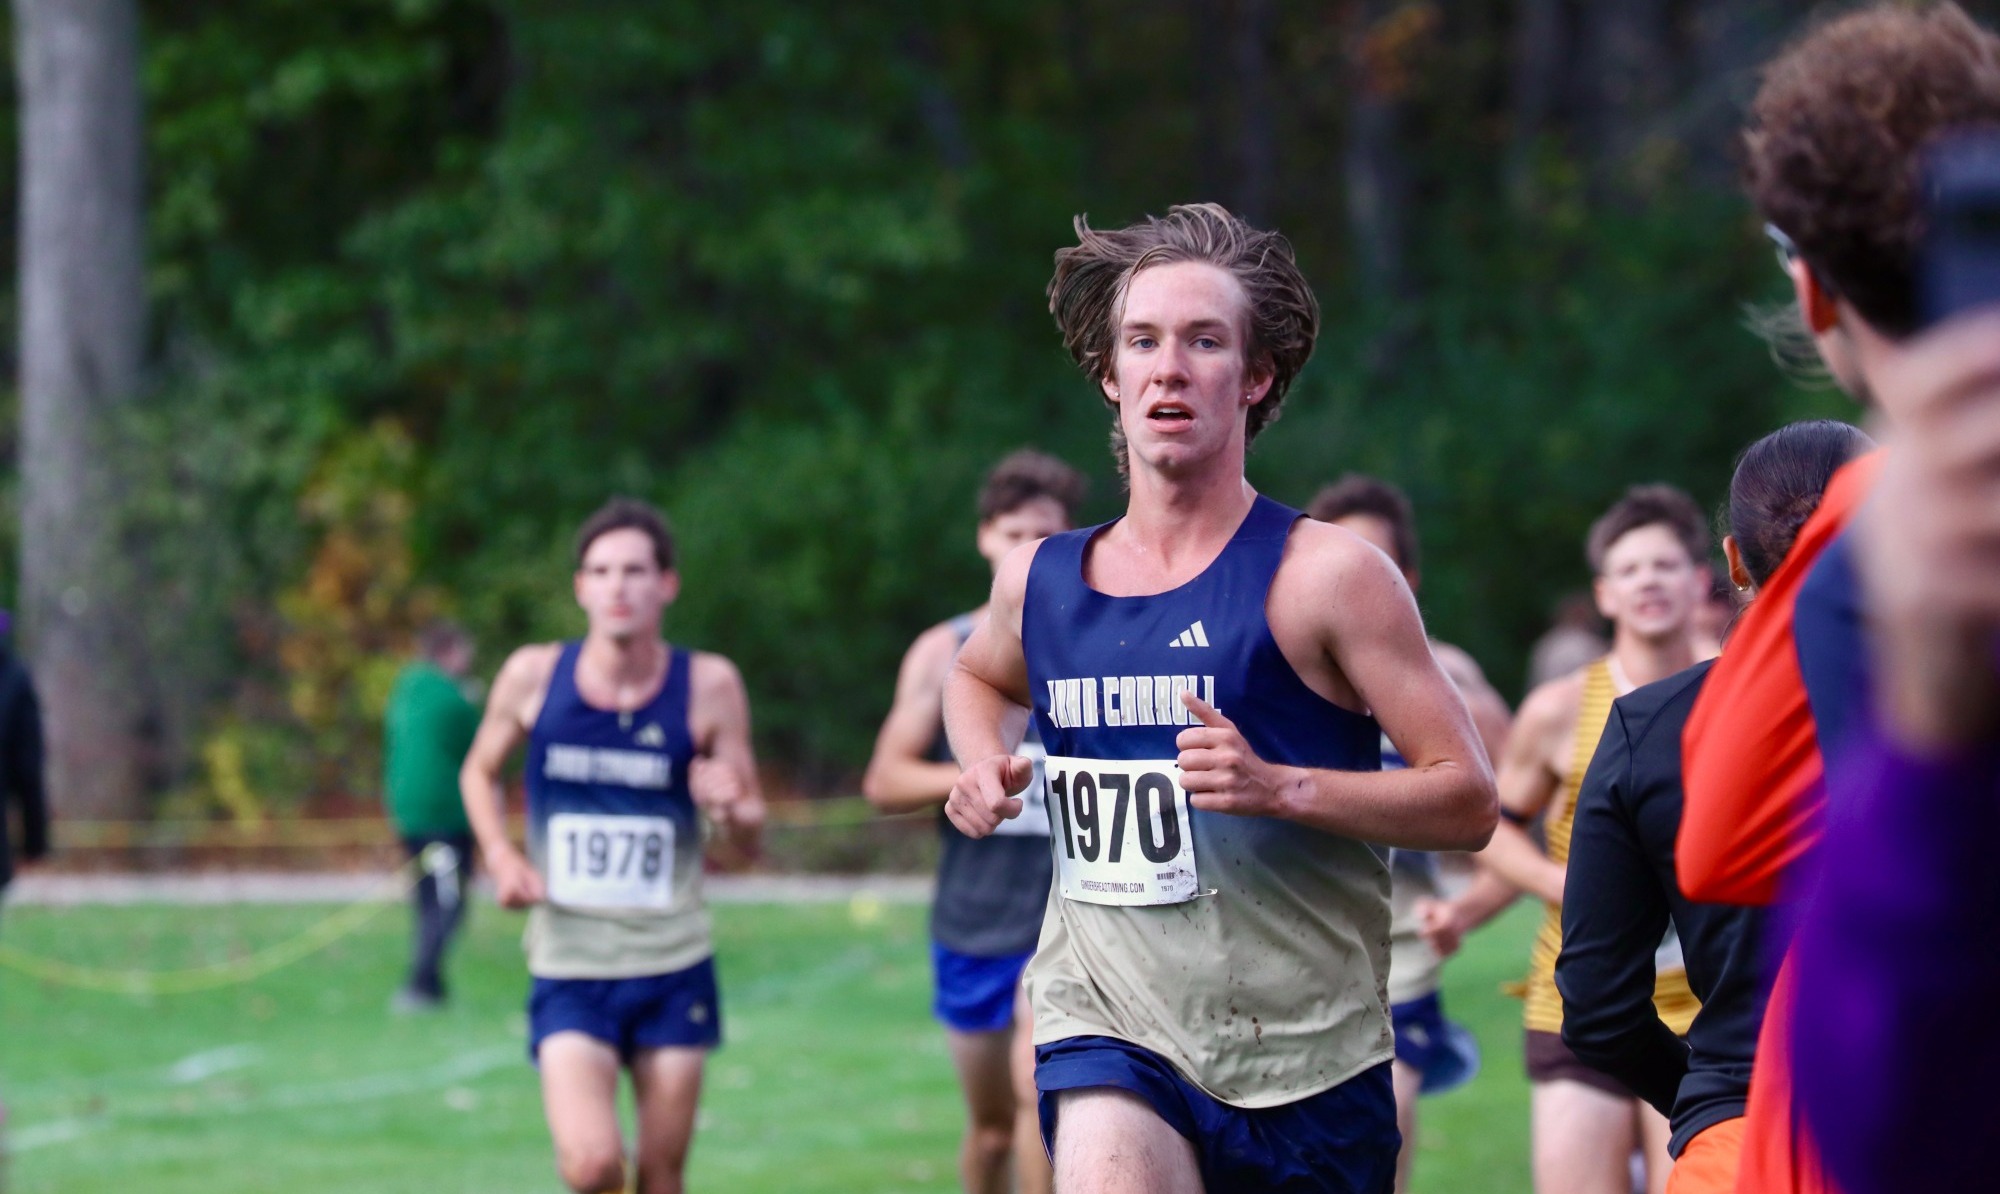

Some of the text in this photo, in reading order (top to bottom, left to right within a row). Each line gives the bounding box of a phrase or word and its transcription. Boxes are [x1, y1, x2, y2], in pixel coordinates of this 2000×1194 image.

[1047, 675, 1222, 728] JOHN CARROLL
[1051, 770, 1182, 864] 1970
[567, 830, 663, 880] 1978
